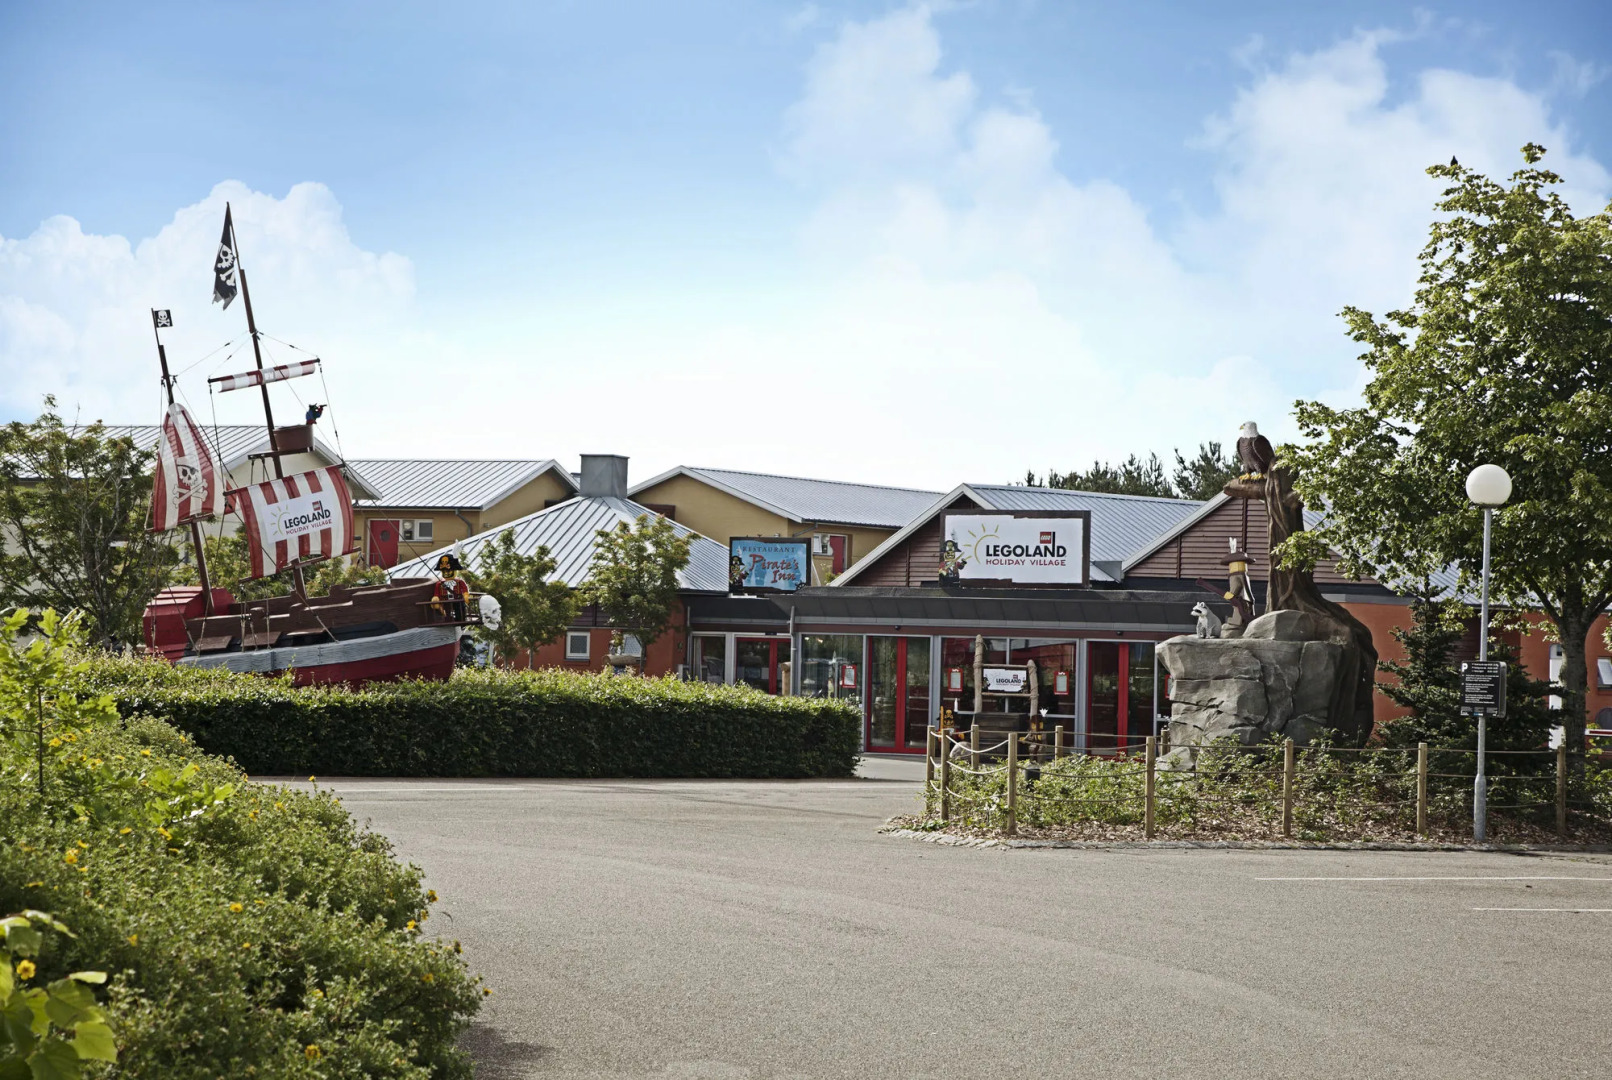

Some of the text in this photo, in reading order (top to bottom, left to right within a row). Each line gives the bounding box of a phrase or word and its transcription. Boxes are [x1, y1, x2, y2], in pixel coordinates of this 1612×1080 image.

[284, 501, 331, 529] LEGOLAND
[286, 519, 332, 535] HOLIDAY VILLAGE
[986, 532, 1067, 557] LEGOLAND
[749, 554, 799, 571] Pirate's
[771, 569, 796, 584] Inn
[1462, 663, 1468, 672] P
